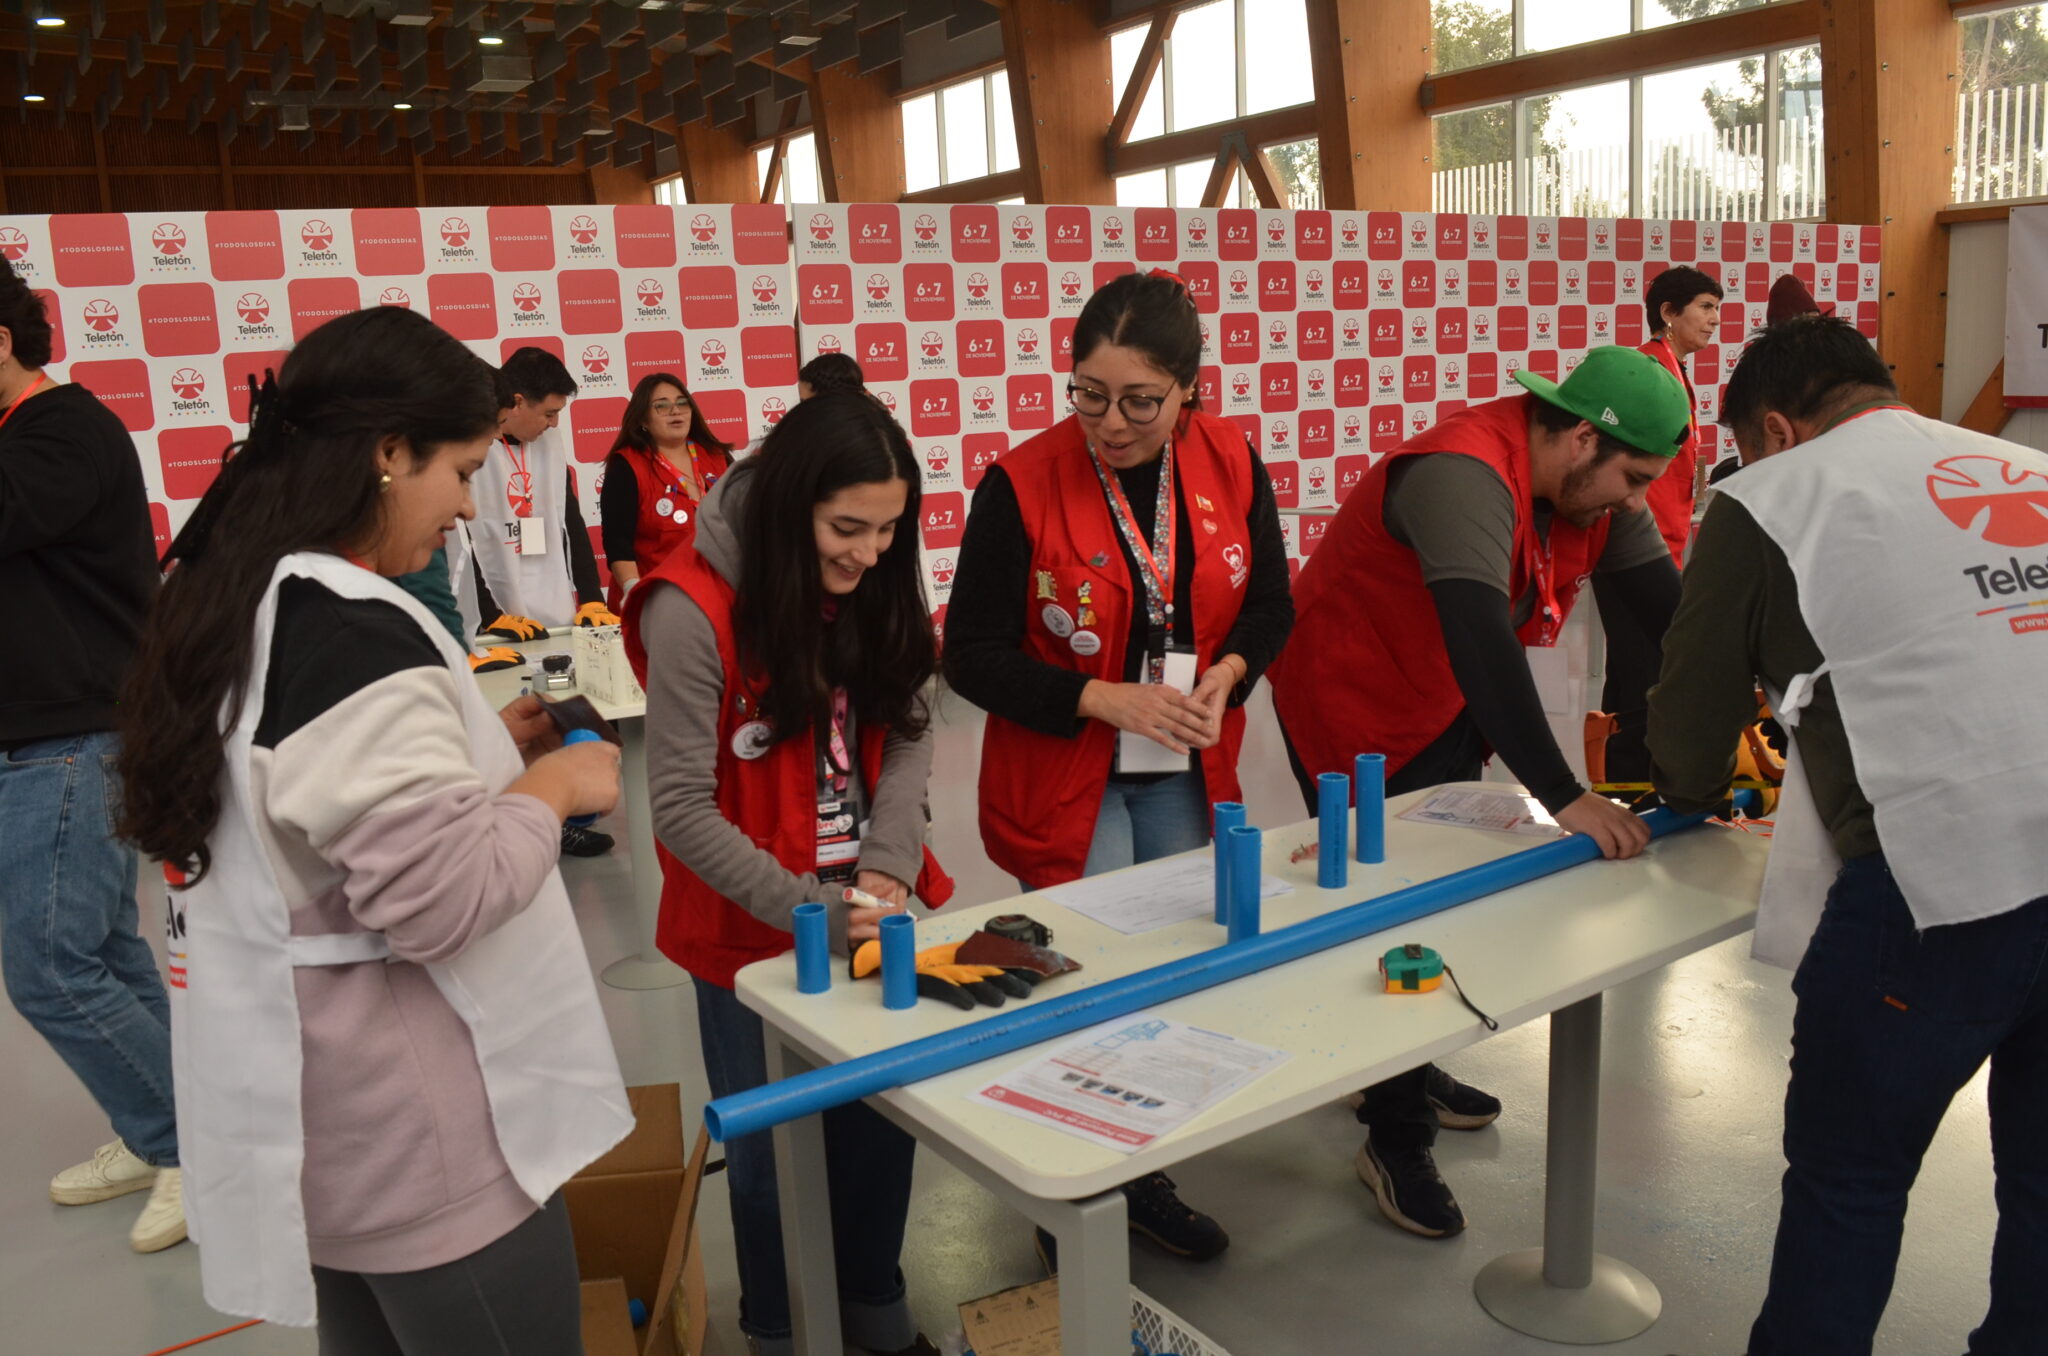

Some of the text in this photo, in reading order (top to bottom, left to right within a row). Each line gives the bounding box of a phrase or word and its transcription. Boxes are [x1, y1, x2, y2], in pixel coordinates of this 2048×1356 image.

[571, 244, 601, 253] Teletón
[691, 241, 719, 250] Teletón
[302, 251, 337, 262] Teletón
[442, 248, 474, 257] Teletón
[154, 254, 191, 267] Teletón
[753, 302, 780, 311] Teletón
[638, 307, 667, 316] Teletón
[513, 312, 545, 322] Teletón
[238, 323, 274, 336] Teletón
[85, 331, 124, 344] Teletón
[921, 358, 945, 366] Teletón
[702, 367, 729, 376] Teletón
[583, 373, 613, 383] Teletón
[173, 398, 209, 411] Teletón
[972, 411, 996, 420] Teletón
[927, 471, 950, 480] Teletón
[1963, 555, 2048, 599] Tele
